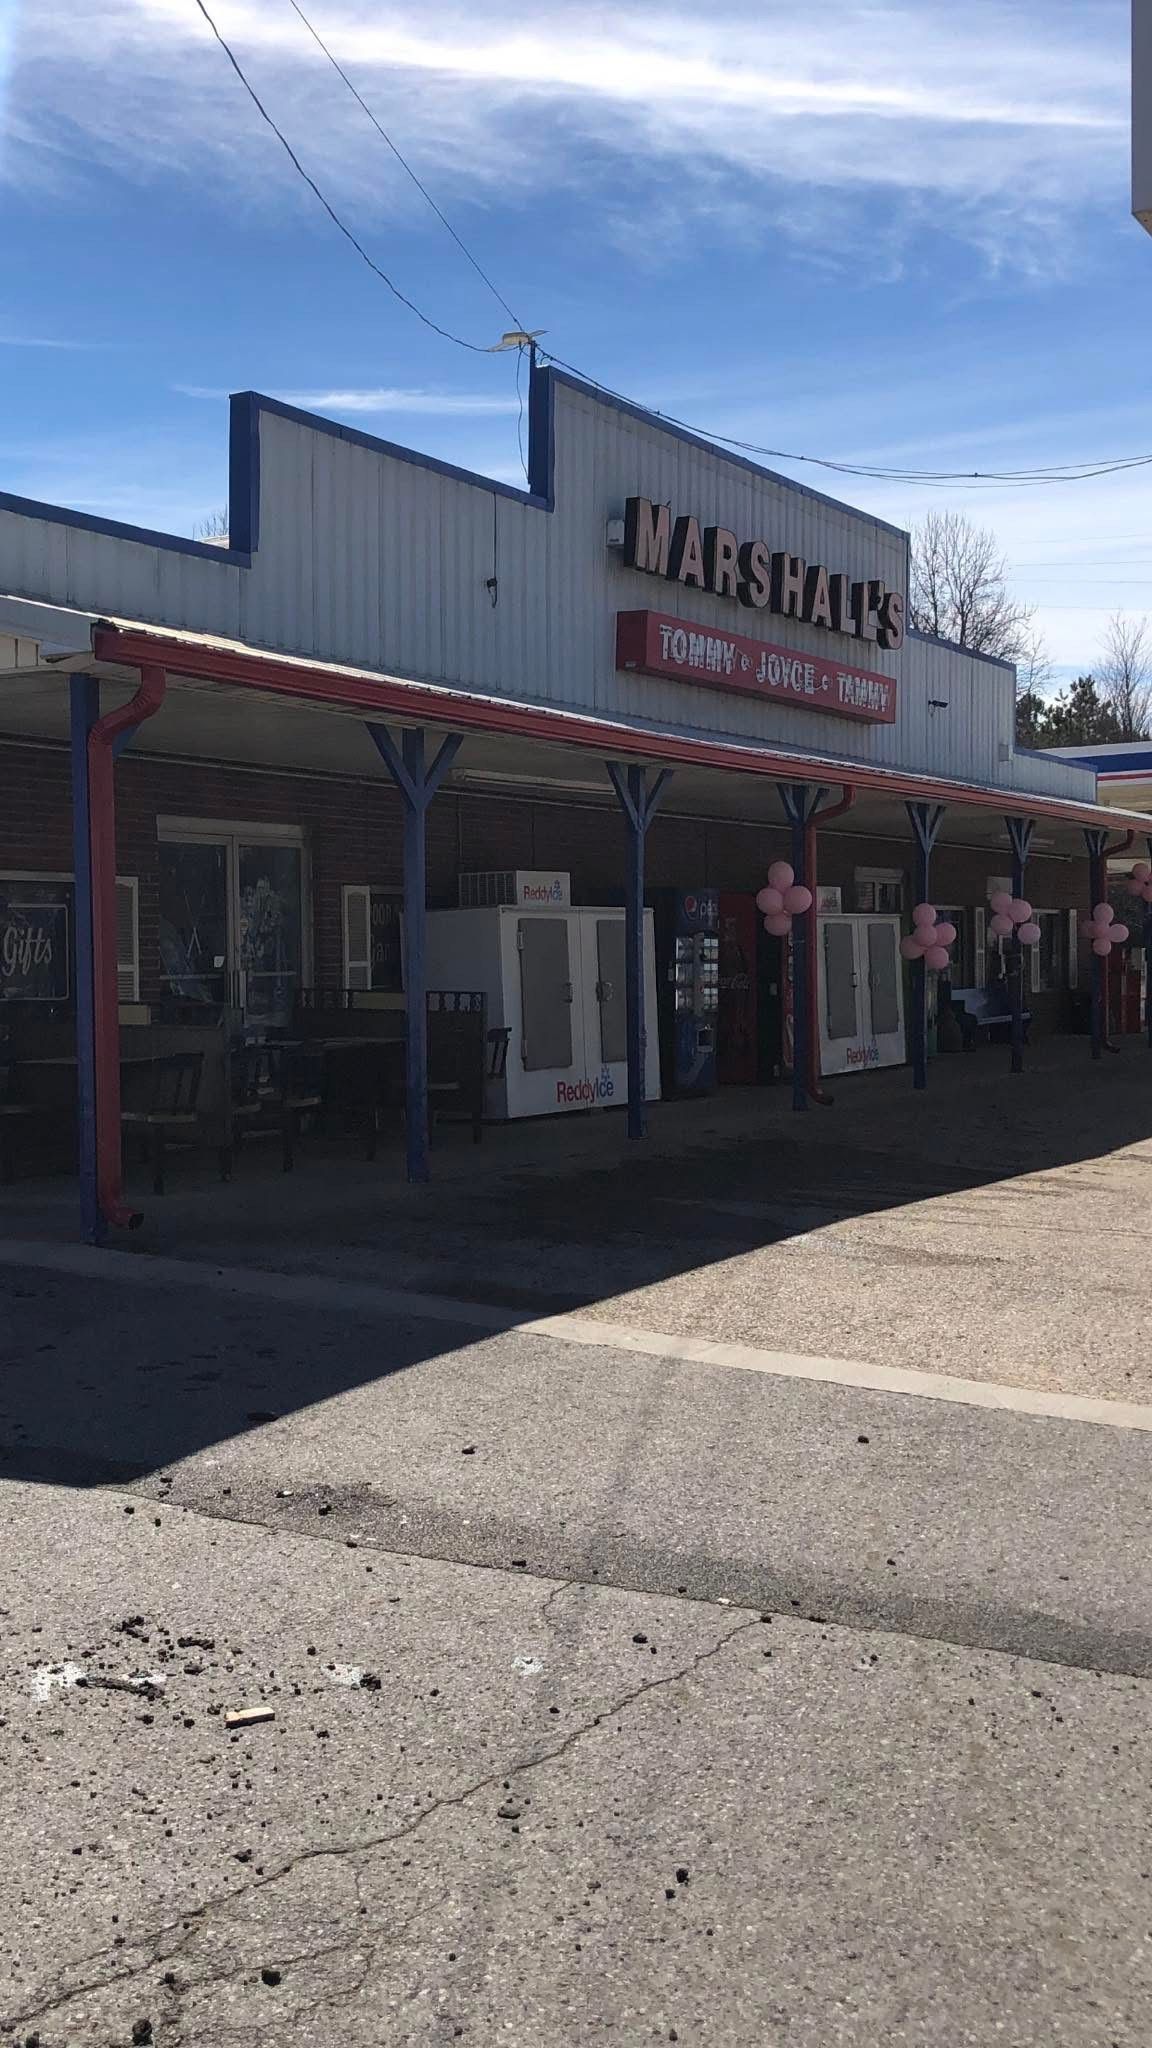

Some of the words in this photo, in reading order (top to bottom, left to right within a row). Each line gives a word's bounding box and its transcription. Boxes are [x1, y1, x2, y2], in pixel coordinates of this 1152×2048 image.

[624, 496, 903, 650] MARSHALL'S
[659, 623, 736, 675] TOMMY
[756, 651, 815, 695] JOYCE
[836, 671, 889, 712] TAMMY
[2, 926, 53, 977] Gifts
